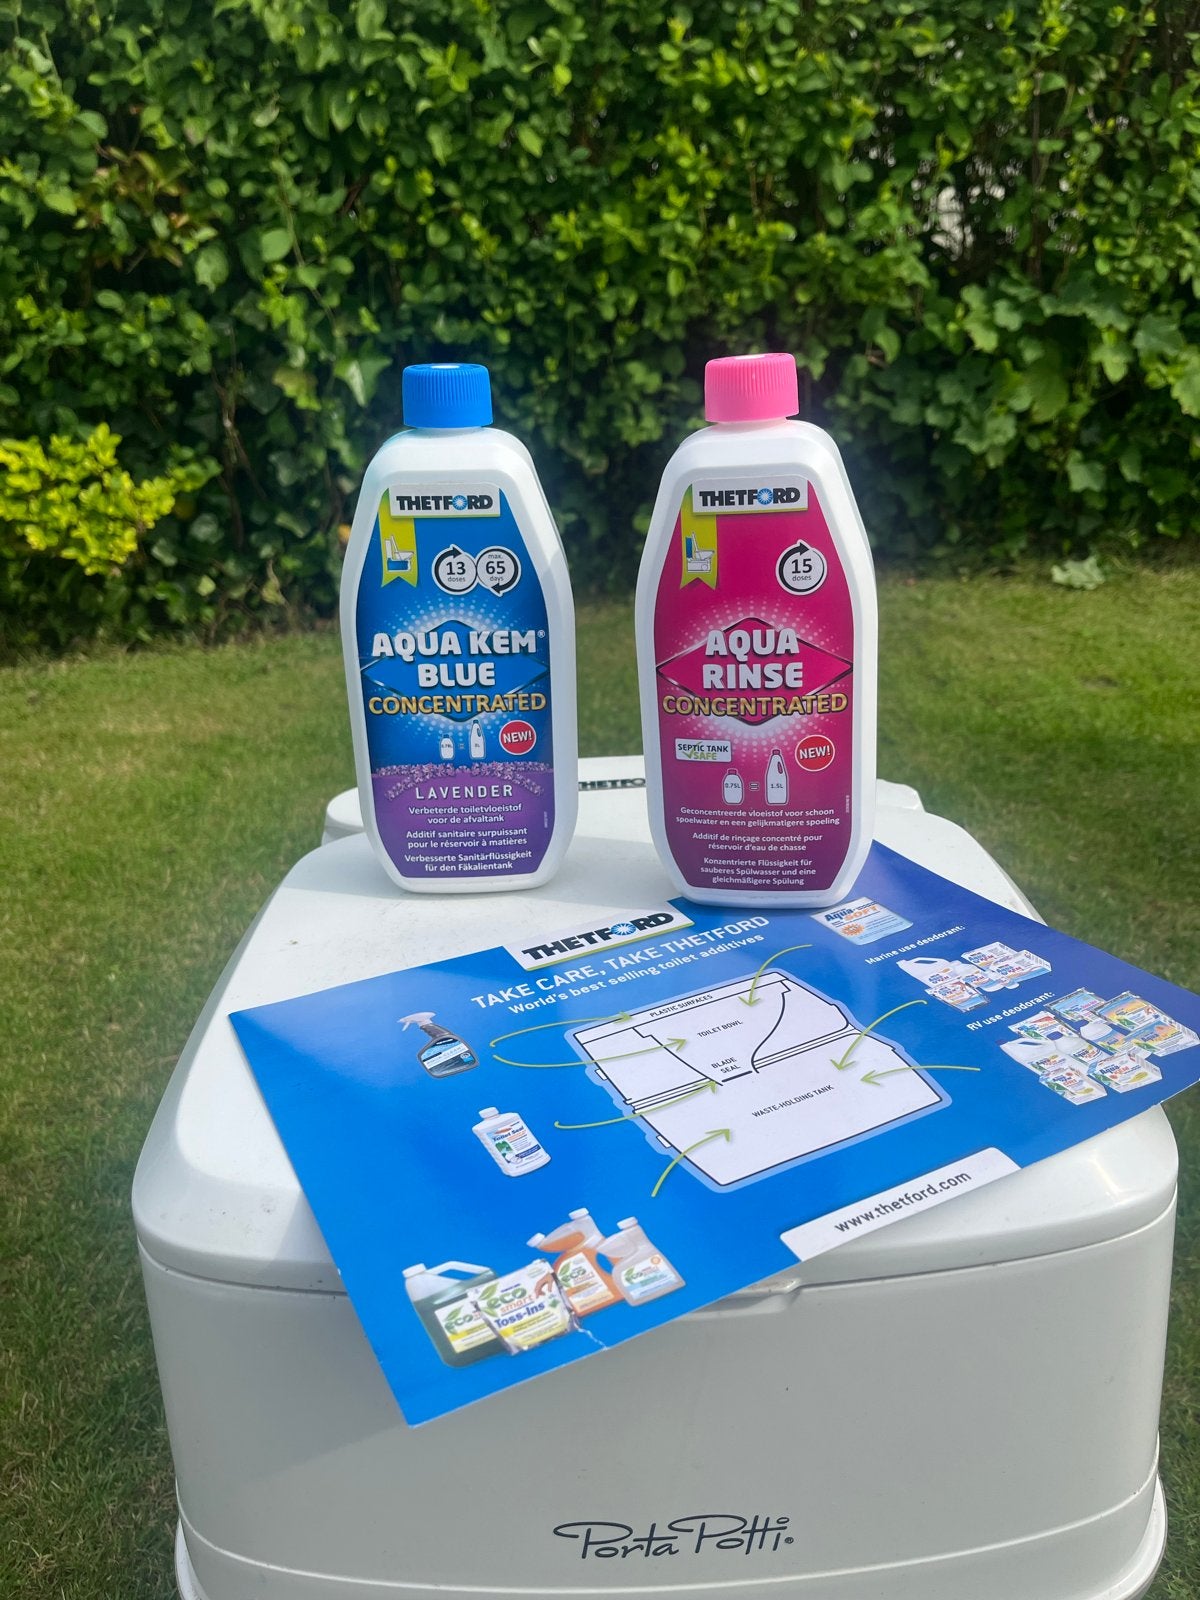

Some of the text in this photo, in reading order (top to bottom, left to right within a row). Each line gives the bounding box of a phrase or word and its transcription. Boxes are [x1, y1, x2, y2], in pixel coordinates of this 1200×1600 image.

[396, 495, 493, 511] THETFORD
[699, 487, 801, 507] THETFORD
[446, 561, 466, 576] 13
[485, 560, 506, 575] 65
[791, 558, 813, 574] 15
[792, 574, 812, 582] doses
[371, 631, 462, 662] AQUA
[705, 628, 800, 662] AQUA
[418, 662, 495, 688] BLUE
[702, 662, 803, 689] RINSE
[368, 692, 547, 715] CONCENTRATED
[662, 693, 848, 716] CONCENTRATED
[503, 731, 533, 745] NEW!
[677, 743, 729, 753] SEPTIC TANK
[693, 752, 718, 760] SAFE
[799, 746, 831, 760] NEW!
[415, 784, 513, 800] LAVENDER
[409, 803, 522, 815] Verbeterde toiletvloeistof
[680, 806, 747, 817] Geconcentreerde
[748, 808, 783, 817] vloeistof
[805, 807, 834, 816] schoon
[427, 814, 504, 824] voor de afvaltank
[676, 815, 718, 827] spoelwater
[747, 817, 804, 829] gelijkmatigere
[806, 816, 840, 827] spoeling
[406, 827, 528, 839] Additif sanitaire surpuissant
[693, 832, 823, 844] Additif de rinçage concentré pour
[407, 836, 527, 850] pour le réservoir à matières
[708, 842, 743, 851] réservoir
[768, 843, 778, 851] de
[779, 843, 807, 851] chasse
[404, 850, 532, 864] Verbesserte Sanitärflüssigkeit
[704, 857, 812, 868] Konzentrierte Flüssigkeit für
[424, 860, 513, 873] für den Fäkalientank
[701, 866, 735, 875] sauberes
[736, 867, 780, 878] Spülwasser
[782, 867, 797, 875] und
[772, 876, 804, 887] Spülung
[521, 912, 674, 960] THETFORD
[865, 950, 899, 966] Marine
[899, 942, 917, 955] use
[916, 924, 966, 948] deodorant:
[471, 915, 770, 1010] TAKE CARE, TAKE THETFORD
[508, 933, 765, 1014] World's best selling toilet additives
[649, 994, 714, 1018] PLASTIC SURFACES
[966, 1020, 984, 1032] RV
[984, 1012, 1003, 1026] use
[1001, 992, 1056, 1018] deodorant:
[697, 1019, 744, 1038] TOILET BOWL
[711, 1056, 737, 1070] BLADE
[720, 1064, 741, 1075] SEAL
[751, 1084, 835, 1119] WASTE-HOLDING TANK
[834, 1171, 972, 1232] www.thetford.com
[486, 1287, 527, 1309] eco
[500, 1294, 534, 1314] smart
[494, 1301, 545, 1329] Toss-Ins
[553, 1521, 679, 1559] Porta
